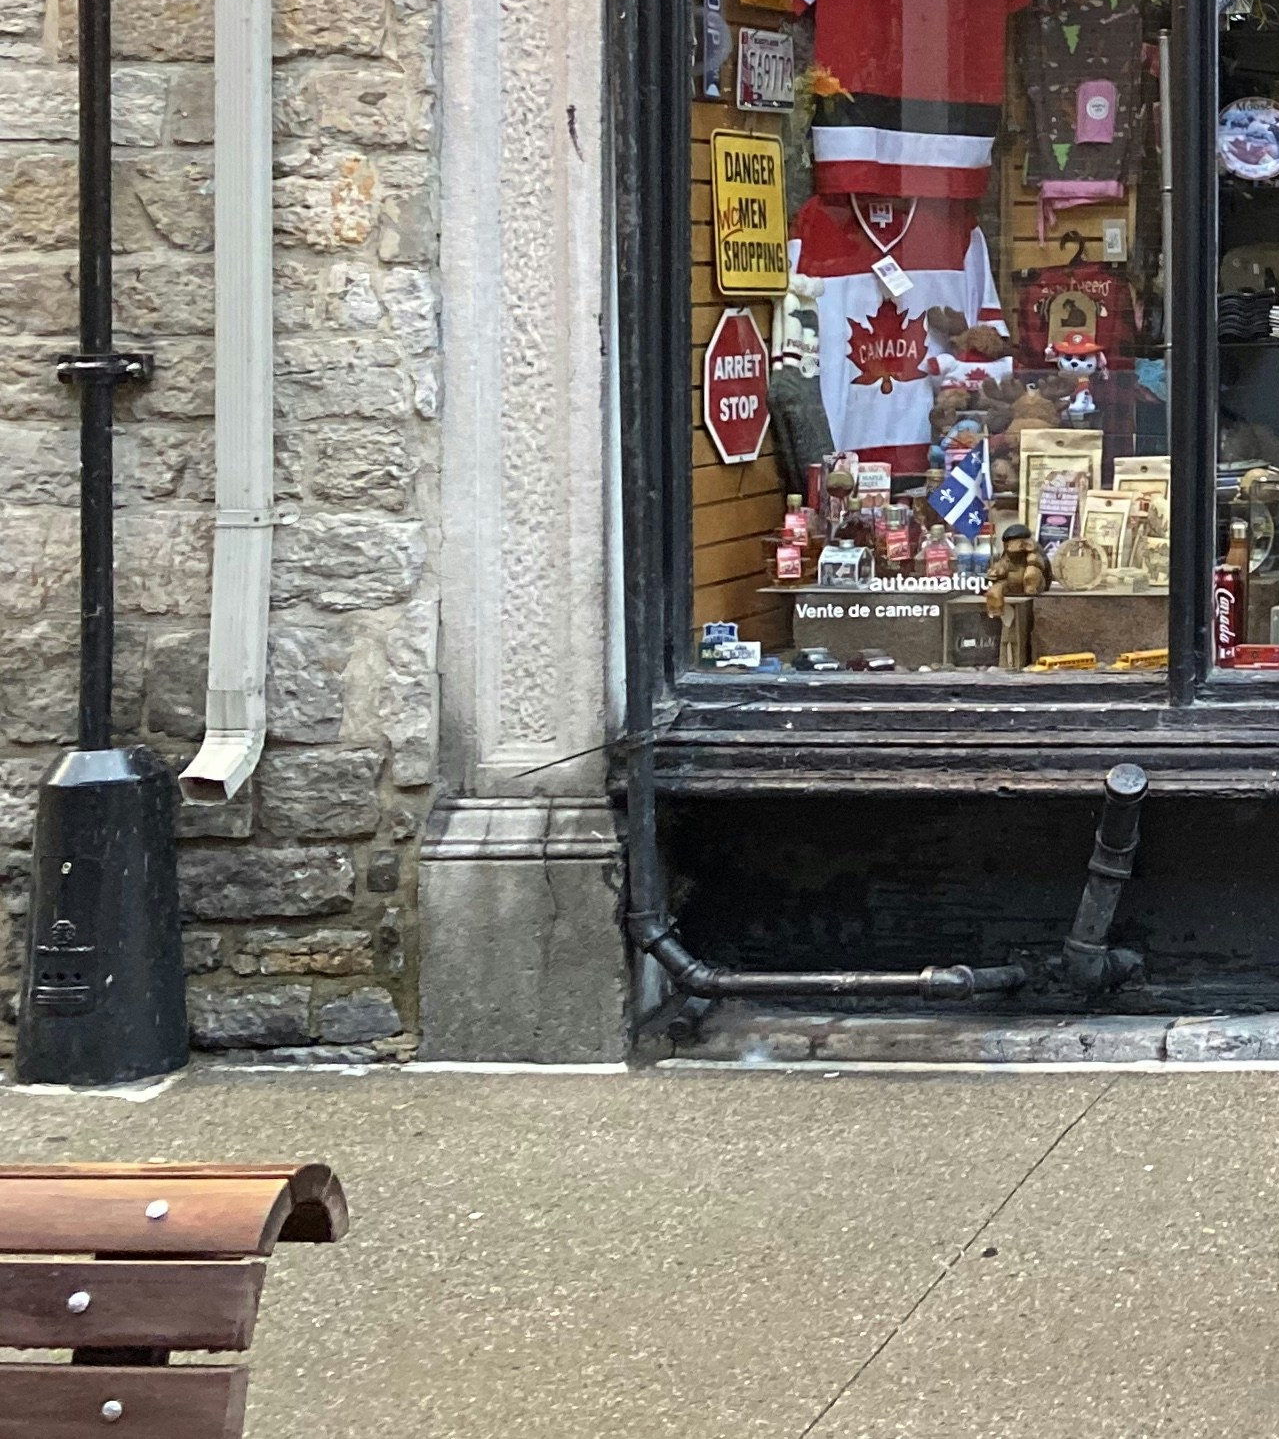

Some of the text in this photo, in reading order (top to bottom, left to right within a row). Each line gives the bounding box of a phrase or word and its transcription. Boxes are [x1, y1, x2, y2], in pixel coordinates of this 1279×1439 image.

[724, 151, 775, 186] DANGER
[723, 241, 784, 273] SHOPPING
[714, 349, 761, 381] ARRÊT
[859, 338, 918, 363] CANADA
[719, 395, 759, 422] STOP
[869, 573, 993, 594] automatiqu
[796, 604, 940, 618] Vente de camera
[1215, 588, 1236, 644] Canada
